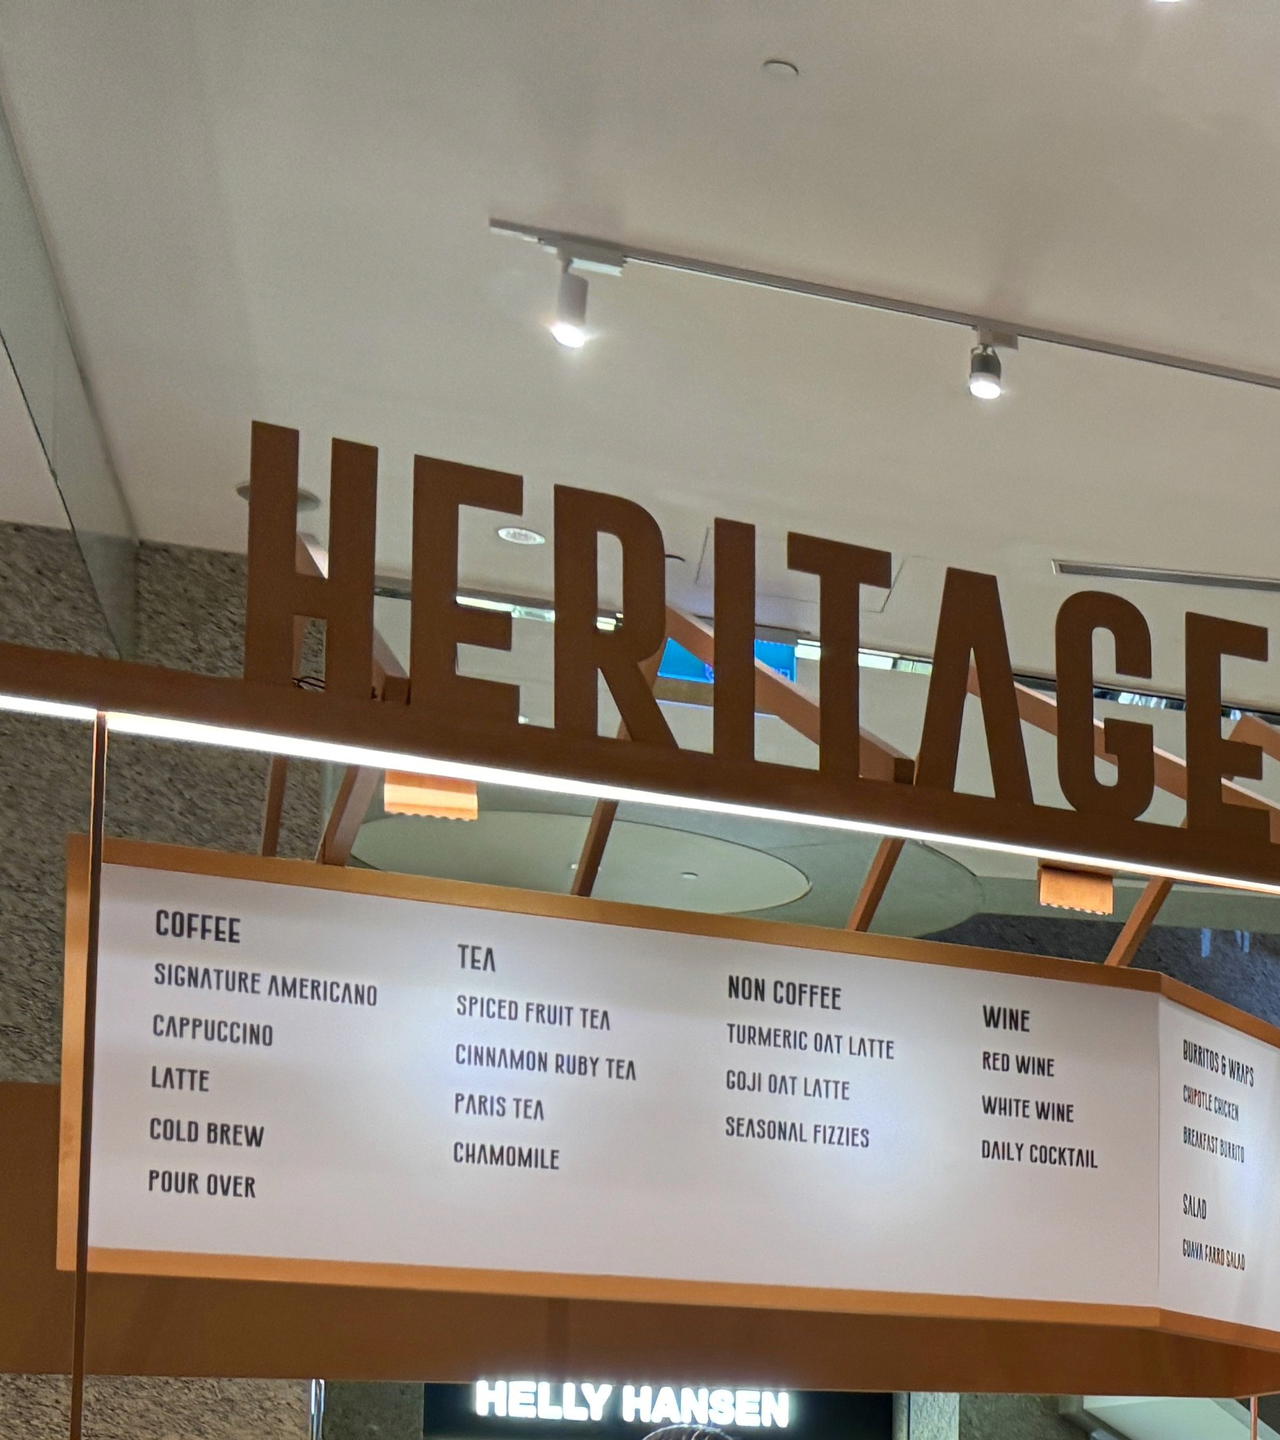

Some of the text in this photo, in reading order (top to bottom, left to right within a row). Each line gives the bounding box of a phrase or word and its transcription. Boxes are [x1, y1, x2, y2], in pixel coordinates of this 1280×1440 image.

[244, 420, 1270, 834] HERITAGE
[156, 910, 240, 943] COFFEE
[458, 944, 495, 972] TEA
[155, 963, 377, 1006] SIGNATURE AMERICANO
[729, 975, 841, 1010] NON COFFEE
[457, 995, 610, 1030] SPICED FRUIT TEA
[983, 1005, 1029, 1032] WINE
[153, 1014, 272, 1046] CAPPUCCINO
[727, 1023, 894, 1059] TURMERIC OAT LATTE
[456, 1044, 636, 1080] CINNAMON RUBY TEA
[983, 1051, 1054, 1077] RED WINE
[1183, 1039, 1254, 1087] BURRITOS & WRAPS
[152, 1066, 209, 1092] LATTE
[727, 1070, 849, 1100] GOJI OAT LATTE
[455, 1093, 544, 1120] PARIS TEA
[982, 1095, 1073, 1122] WHITE WINE
[1183, 1085, 1239, 1122] CHIPOTLE CHICKEN
[150, 1118, 264, 1147] COLD BREW
[726, 1117, 869, 1148] SEASONAL FIZZIES
[1183, 1126, 1244, 1163] BREAKFAST BURRITO
[454, 1142, 559, 1169] CHAMOMILE
[982, 1140, 1098, 1168] DAILY COCKTAIL
[149, 1170, 255, 1198] POUR OVER
[1183, 1193, 1206, 1220] SALAD
[1183, 1239, 1203, 1260] GUAVA
[1226, 1250, 1245, 1271] SALAD
[475, 1380, 789, 1428] HELLY HANSEN
